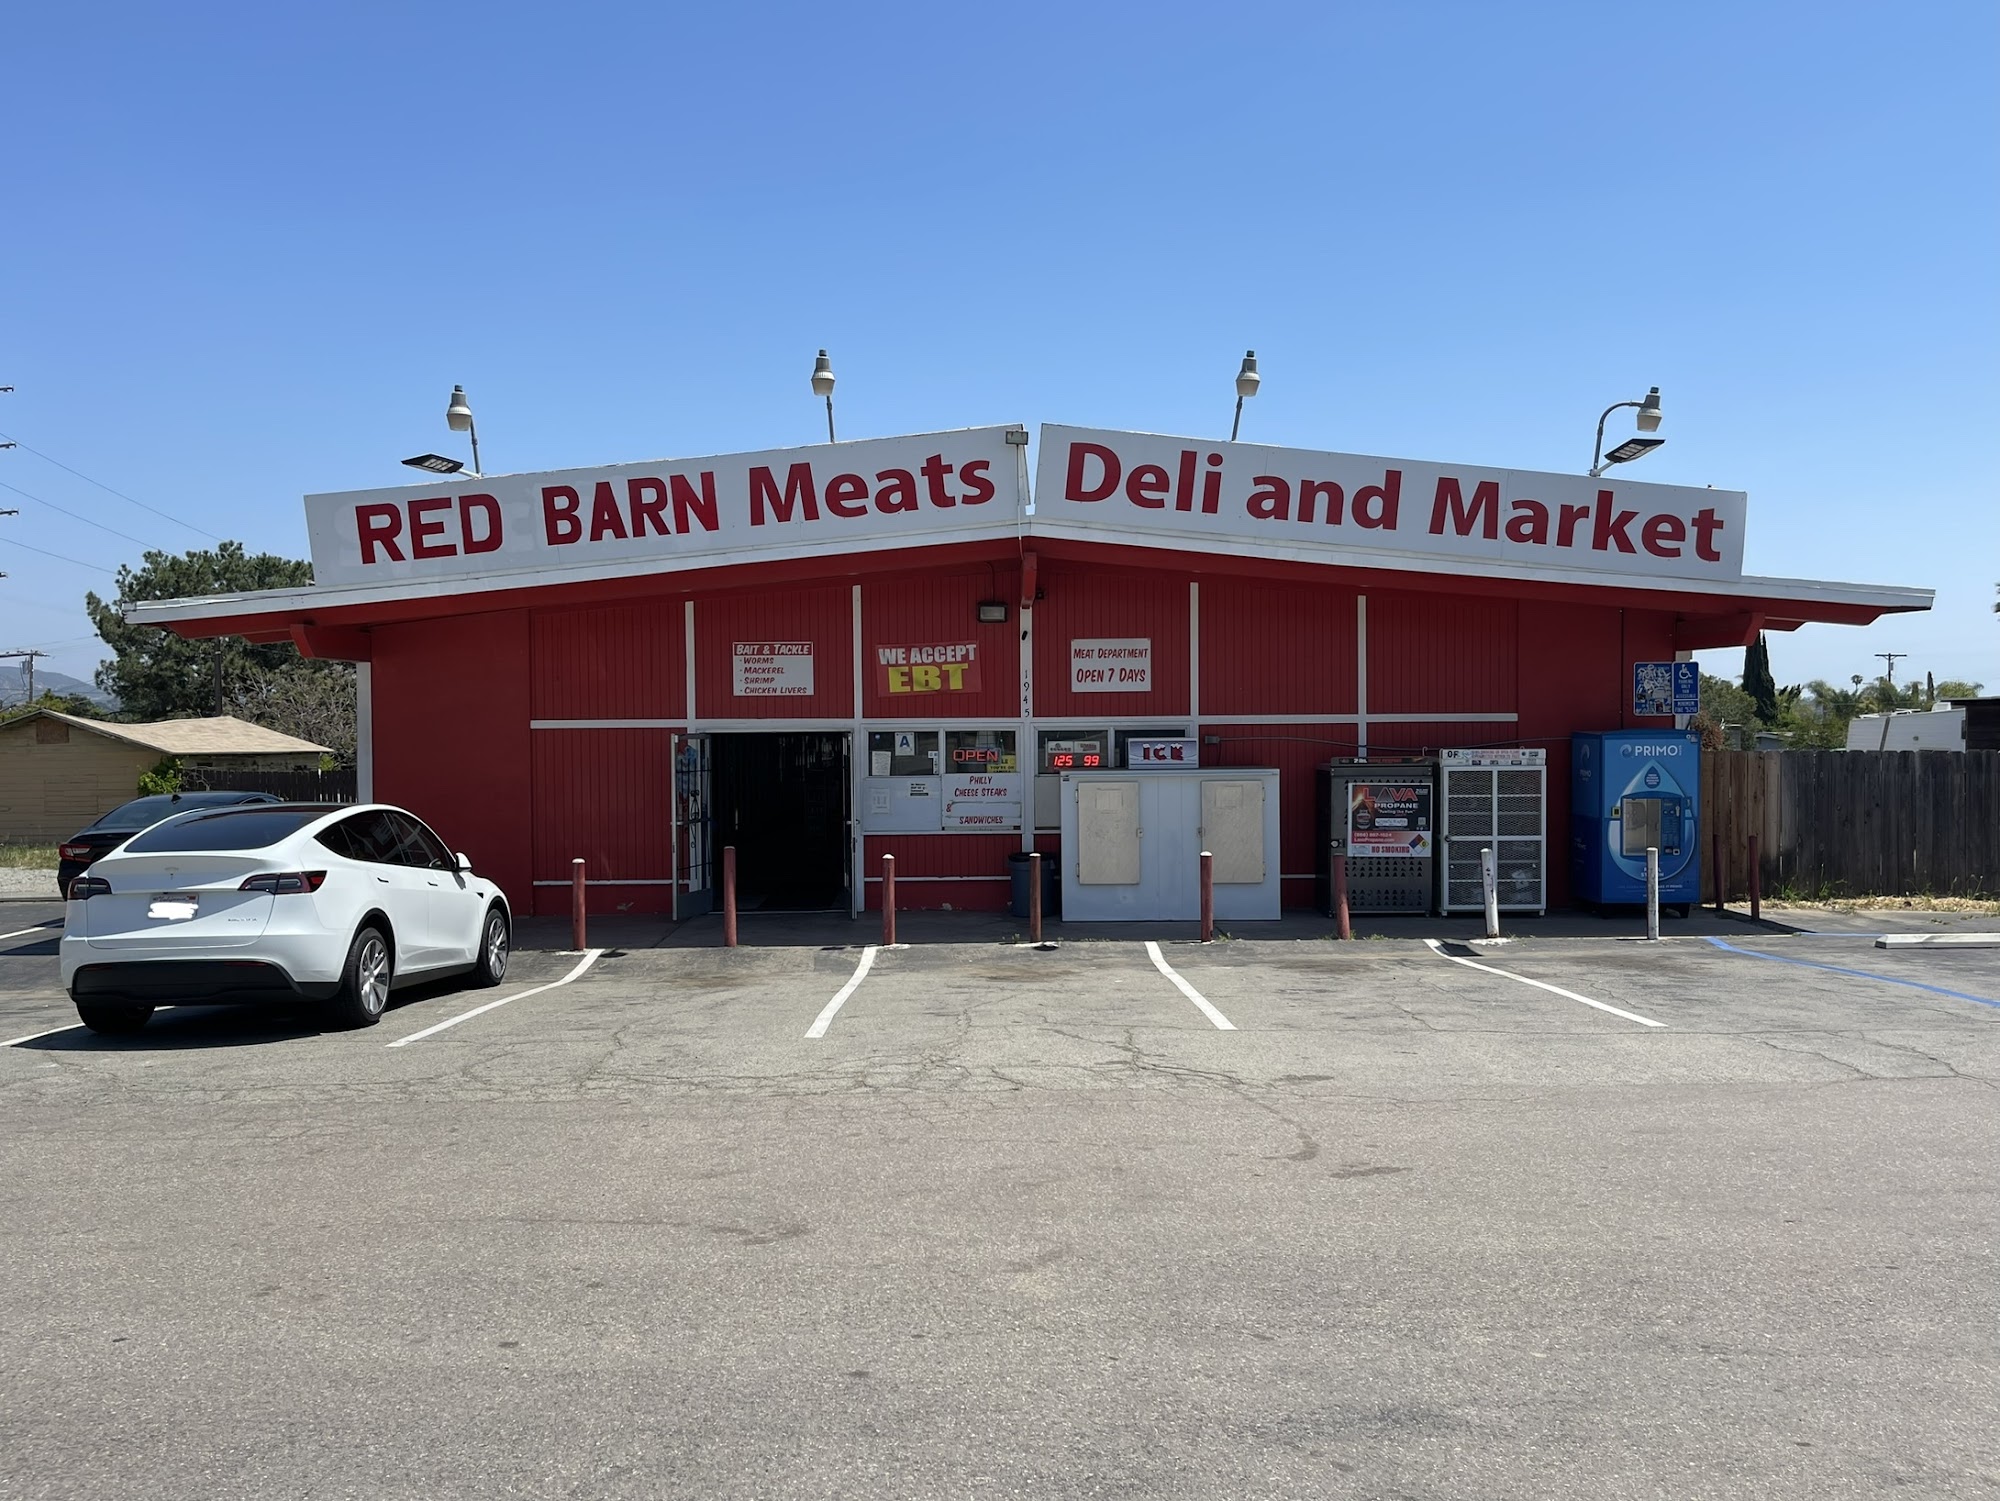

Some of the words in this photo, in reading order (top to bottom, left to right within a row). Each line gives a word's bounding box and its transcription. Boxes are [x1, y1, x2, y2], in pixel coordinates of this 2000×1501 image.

[1064, 442, 1224, 514] Deli
[1245, 470, 1402, 530] and
[1428, 476, 1724, 562] Market
[355, 493, 503, 565] RED
[542, 472, 719, 545] BARN
[749, 453, 996, 526] Meats
[736, 644, 759, 655] BAIT
[763, 645, 770, 655] &
[774, 644, 810, 655] TACKLE
[878, 648, 906, 664] WE
[910, 644, 976, 664] ACCEPT
[1073, 648, 1095, 659] MEAT
[1097, 648, 1149, 659] DEPARTMENT
[743, 667, 785, 675] MACKEREL
[1076, 668, 1104, 683] OPEN
[1108, 668, 1115, 682] 7
[1119, 668, 1146, 682] DAYS
[888, 663, 968, 693] EBT
[744, 686, 777, 694] CHICKEN
[780, 686, 808, 694] LIVERS
[900, 735, 910, 748] A
[953, 749, 998, 762] OPEN
[1142, 743, 1184, 761] ICE
[1635, 745, 1678, 757] PRIMO
[1054, 755, 1073, 766] 125
[1083, 755, 1099, 766] 99
[969, 776, 993, 785] PHILLY
[954, 788, 979, 797] CHEESE
[981, 788, 1008, 797] STEAKS
[1363, 787, 1419, 803] LAVA
[946, 803, 952, 813] &
[959, 816, 1004, 825] SANDWICHES
